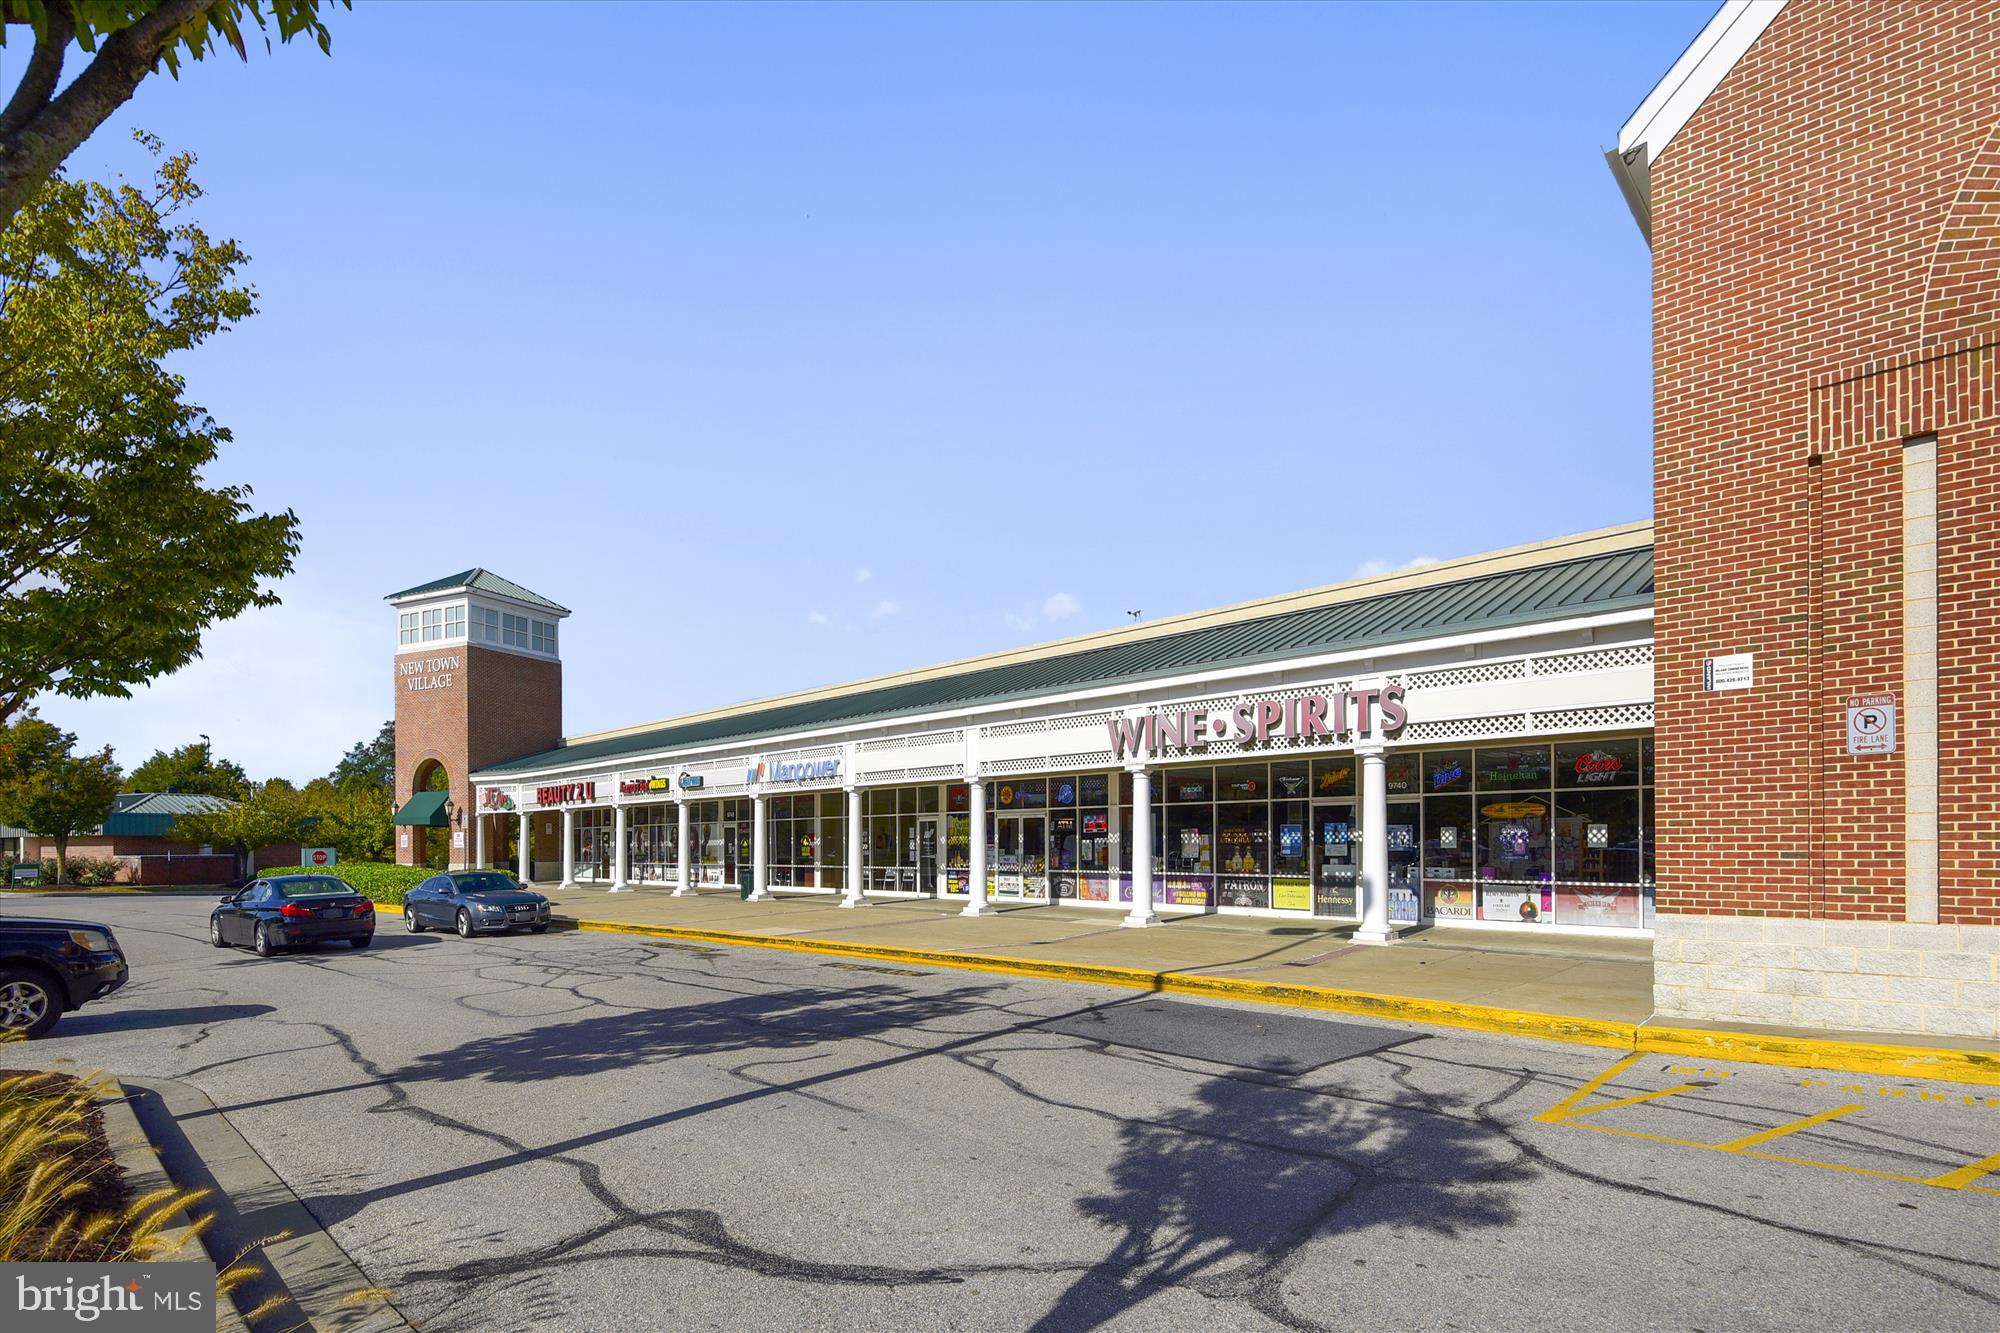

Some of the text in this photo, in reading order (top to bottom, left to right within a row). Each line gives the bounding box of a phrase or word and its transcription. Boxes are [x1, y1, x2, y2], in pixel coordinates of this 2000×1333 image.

[400, 656, 460, 676] NEW TOWN
[408, 673, 454, 691] VILLAGE
[1850, 696, 1891, 707] NO PARKING
[1107, 685, 1407, 754] WINE SPIRITS
[1853, 734, 1889, 743] FIRE LANE
[1575, 753, 1622, 773] Coors
[769, 759, 840, 785] Manpower
[1577, 771, 1617, 783] LIGHT
[1388, 781, 1407, 789] 9740
[537, 781, 595, 805] BEAUTY 2 U
[1317, 894, 1353, 905] Hennessy
[1426, 906, 1471, 916] BACARDI
